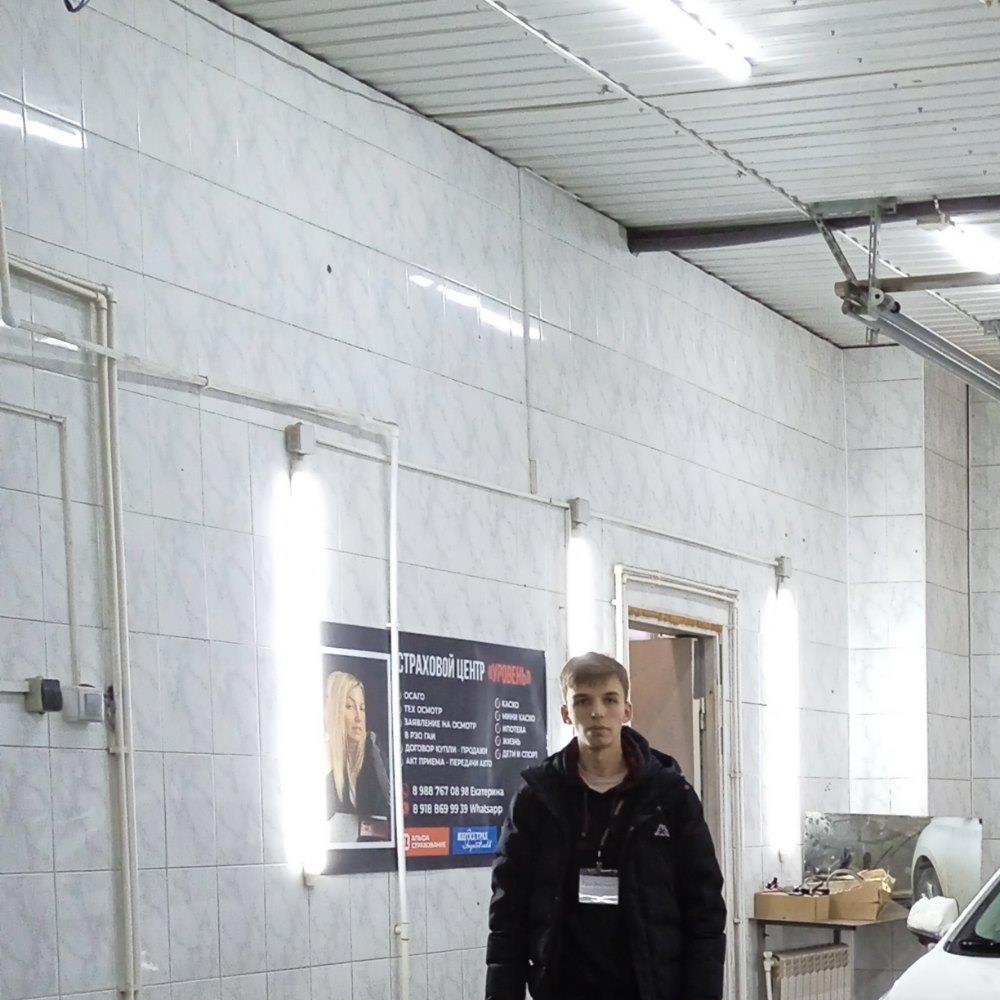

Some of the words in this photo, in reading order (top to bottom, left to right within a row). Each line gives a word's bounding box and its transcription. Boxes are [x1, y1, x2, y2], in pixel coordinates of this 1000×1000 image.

[399, 652, 455, 679] СТРАХОВОЙ
[456, 658, 485, 682] ЦЕНТР
[403, 691, 425, 701] ОСАГО
[404, 704, 416, 714] ТЕХ
[417, 705, 443, 715] ОСМОТР
[502, 700, 519, 709] КАСКО
[502, 712, 517, 721] МИНИ
[519, 714, 536, 722] КАСКО
[404, 717, 441, 728] ЗАЯВЛЕНИЕ
[442, 720, 451, 729] НА
[452, 721, 477, 730] ОСМОТР
[502, 725, 526, 734] ИПОТЕКА
[404, 731, 409, 739] В
[424, 732, 436, 740] ГАИ
[502, 738, 521, 746] ЖИЗНЬ
[405, 744, 434, 753] ДОГОВОР
[435, 745, 457, 754] КУПЛИ
[461, 746, 488, 755] ПРОДАЖИ
[502, 750, 516, 759] ДЕТИ
[521, 750, 538, 759] СПОРТ
[406, 757, 417, 765] АКТ
[419, 757, 445, 766] ПРИЕМА
[449, 759, 480, 767] ПЕРЕДАЧИ
[480, 759, 493, 768] АВТО
[412, 785, 418, 796] 8
[419, 785, 433, 796] 988
[434, 786, 449, 796] 767
[450, 786, 460, 796] 08
[460, 786, 469, 796] 98
[470, 786, 505, 798] Екатерина
[412, 803, 418, 814] 8
[419, 804, 432, 814] 918
[434, 804, 449, 814] 869
[449, 804, 459, 814] 99
[459, 804, 468, 814] 39
[469, 803, 503, 816] Whatsapp
